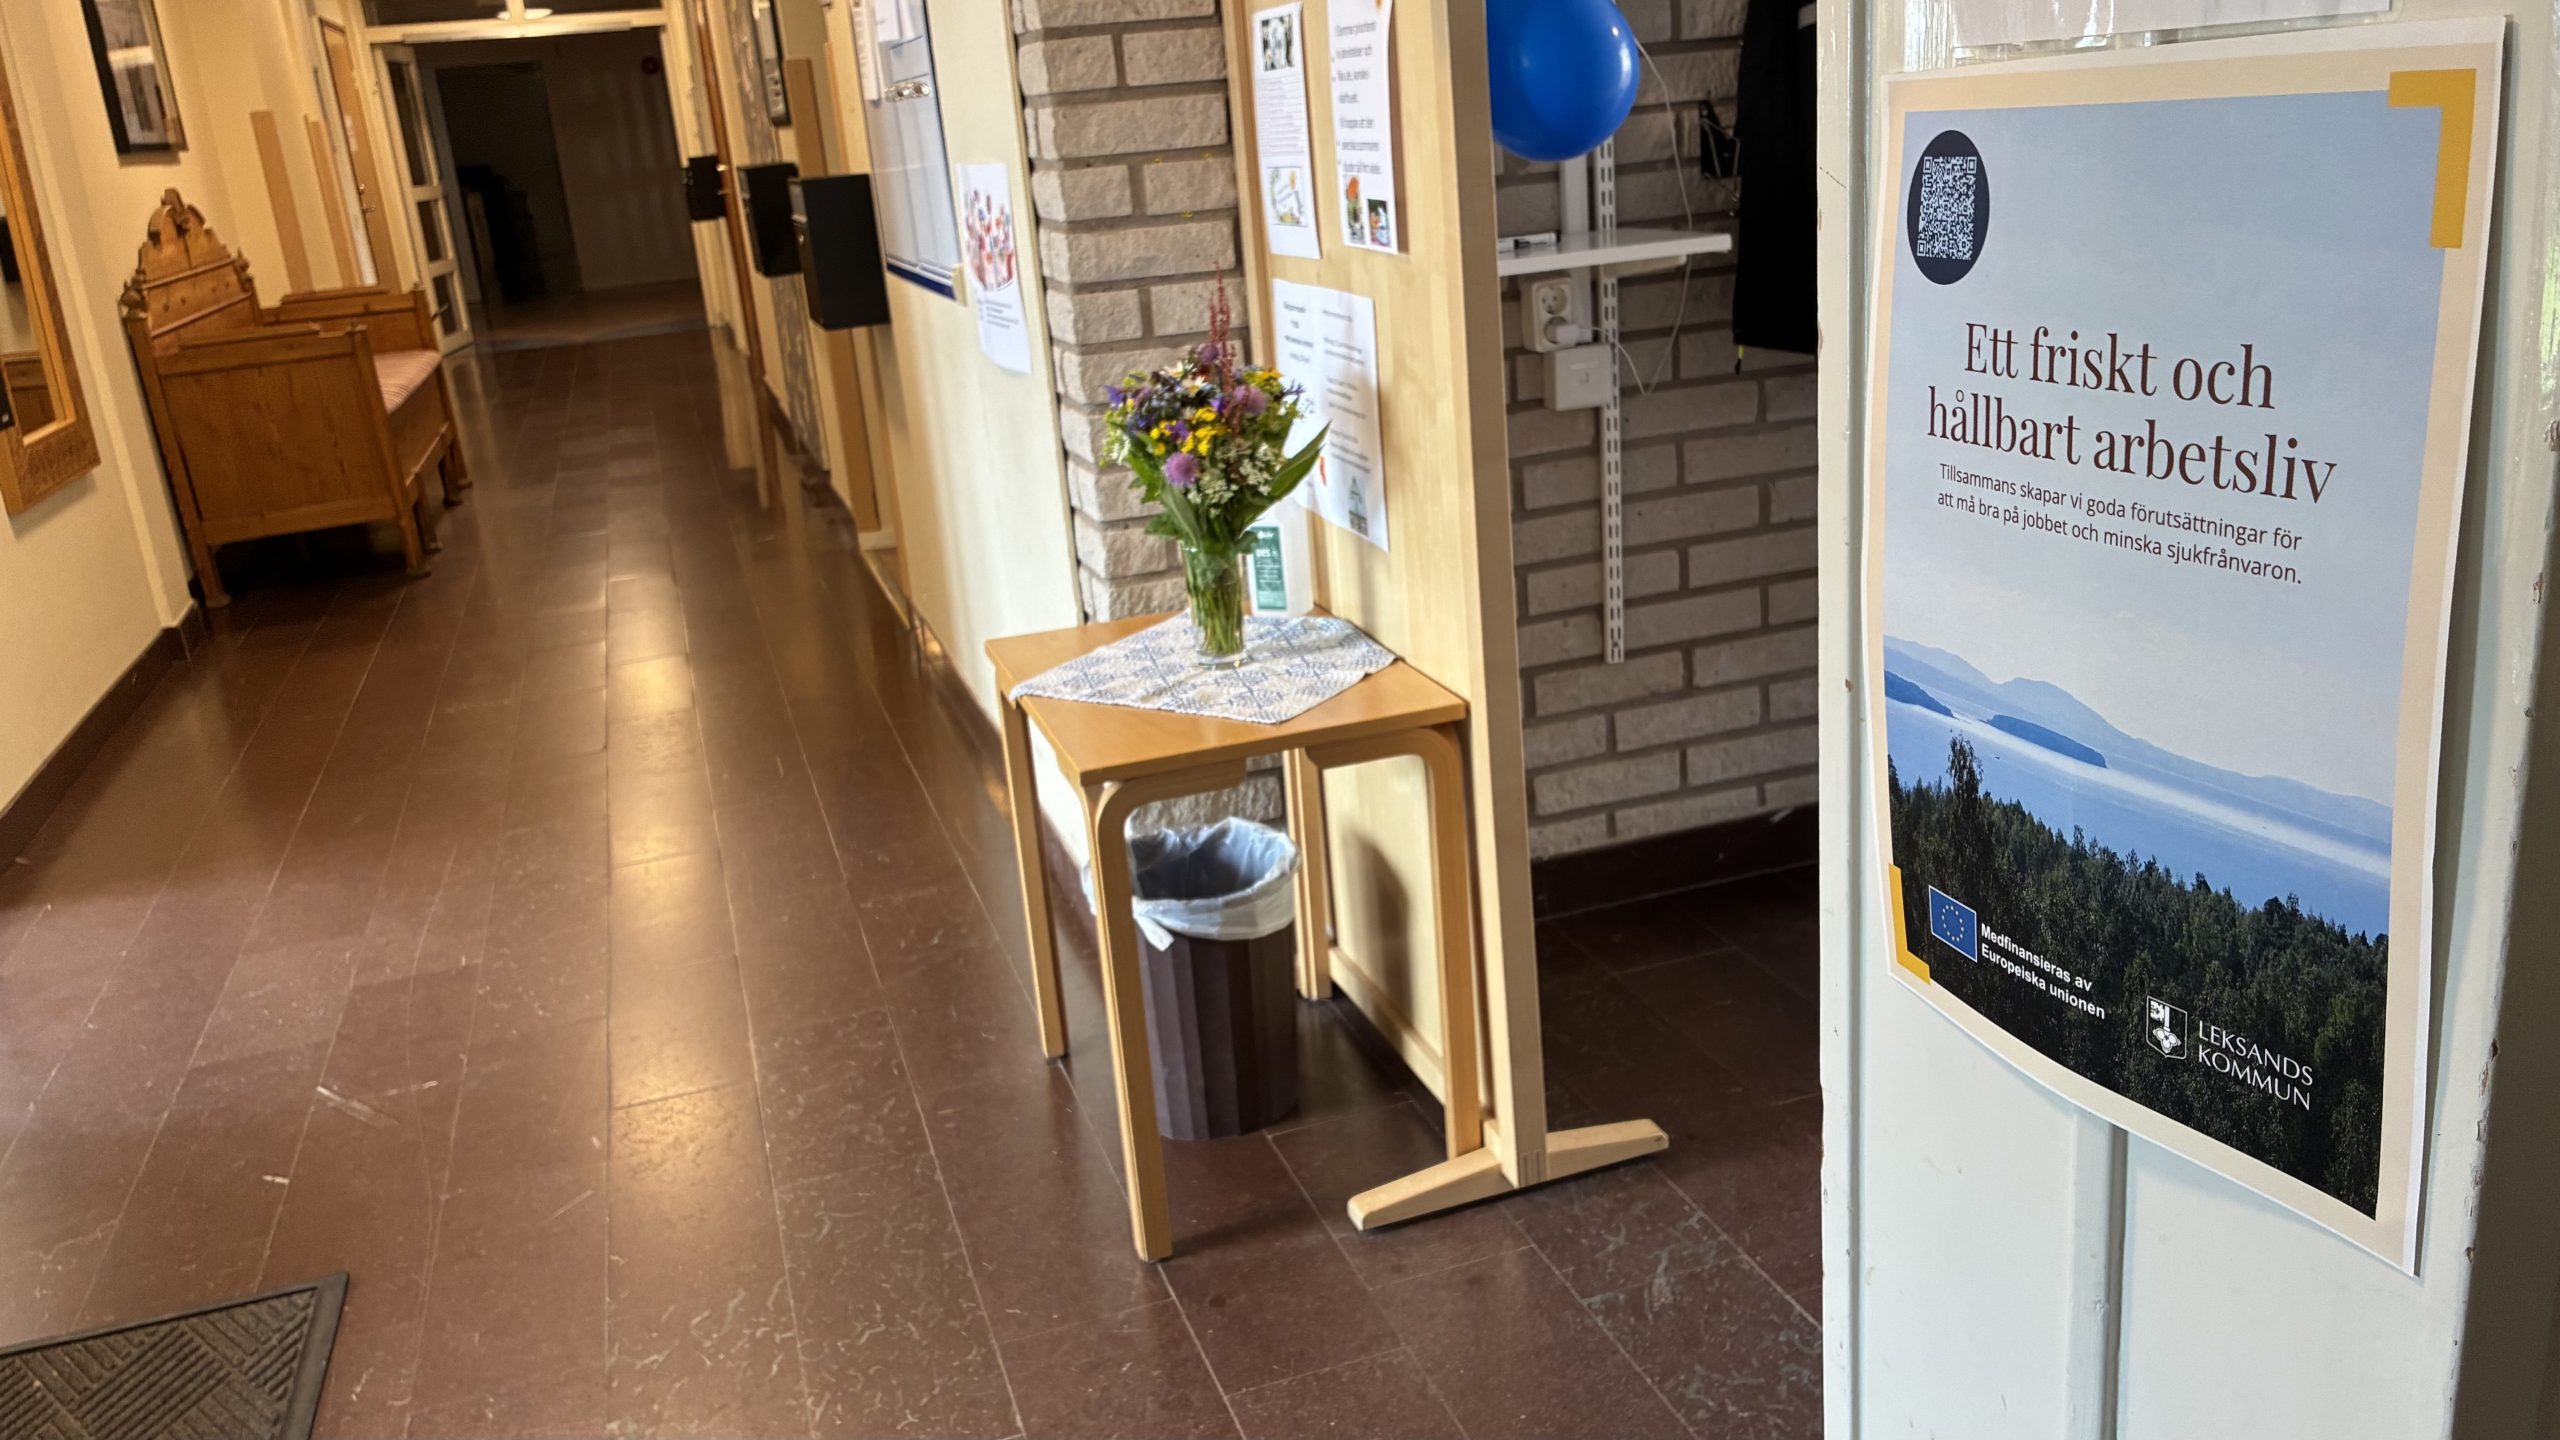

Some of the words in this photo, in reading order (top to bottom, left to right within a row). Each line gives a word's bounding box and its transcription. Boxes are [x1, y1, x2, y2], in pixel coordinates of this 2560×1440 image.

[1965, 322, 2019, 379] Ett
[2029, 325, 2158, 397] friskt
[2173, 343, 2276, 410] och
[1927, 385, 2082, 465] hållbart
[2093, 419, 2338, 504] arbetsliv
[1937, 491, 1954, 508] att
[1957, 496, 1976, 514] må
[1979, 498, 2000, 520] bra
[2003, 506, 2020, 527] på
[2022, 509, 2068, 537] jobbet
[2071, 522, 2099, 543] och
[2103, 530, 2162, 556] minska
[2167, 542, 2303, 585] sjukfrånvaron.
[1939, 463, 2017, 496] Tillsammans
[2020, 481, 2067, 507] skapar
[2070, 493, 2083, 509] vi
[2087, 497, 2126, 518] goda
[2131, 502, 2268, 546] förutsättningar
[2273, 527, 2303, 551] för
[1981, 922, 2071, 983] Medfinansieras
[2074, 976, 2093, 992] av
[1981, 942, 2046, 991] Europeiska
[2049, 983, 2106, 1020] unionen
[2198, 1044, 2311, 1111] KOMMUN
[2199, 1020, 2313, 1086] LEKSANDS
